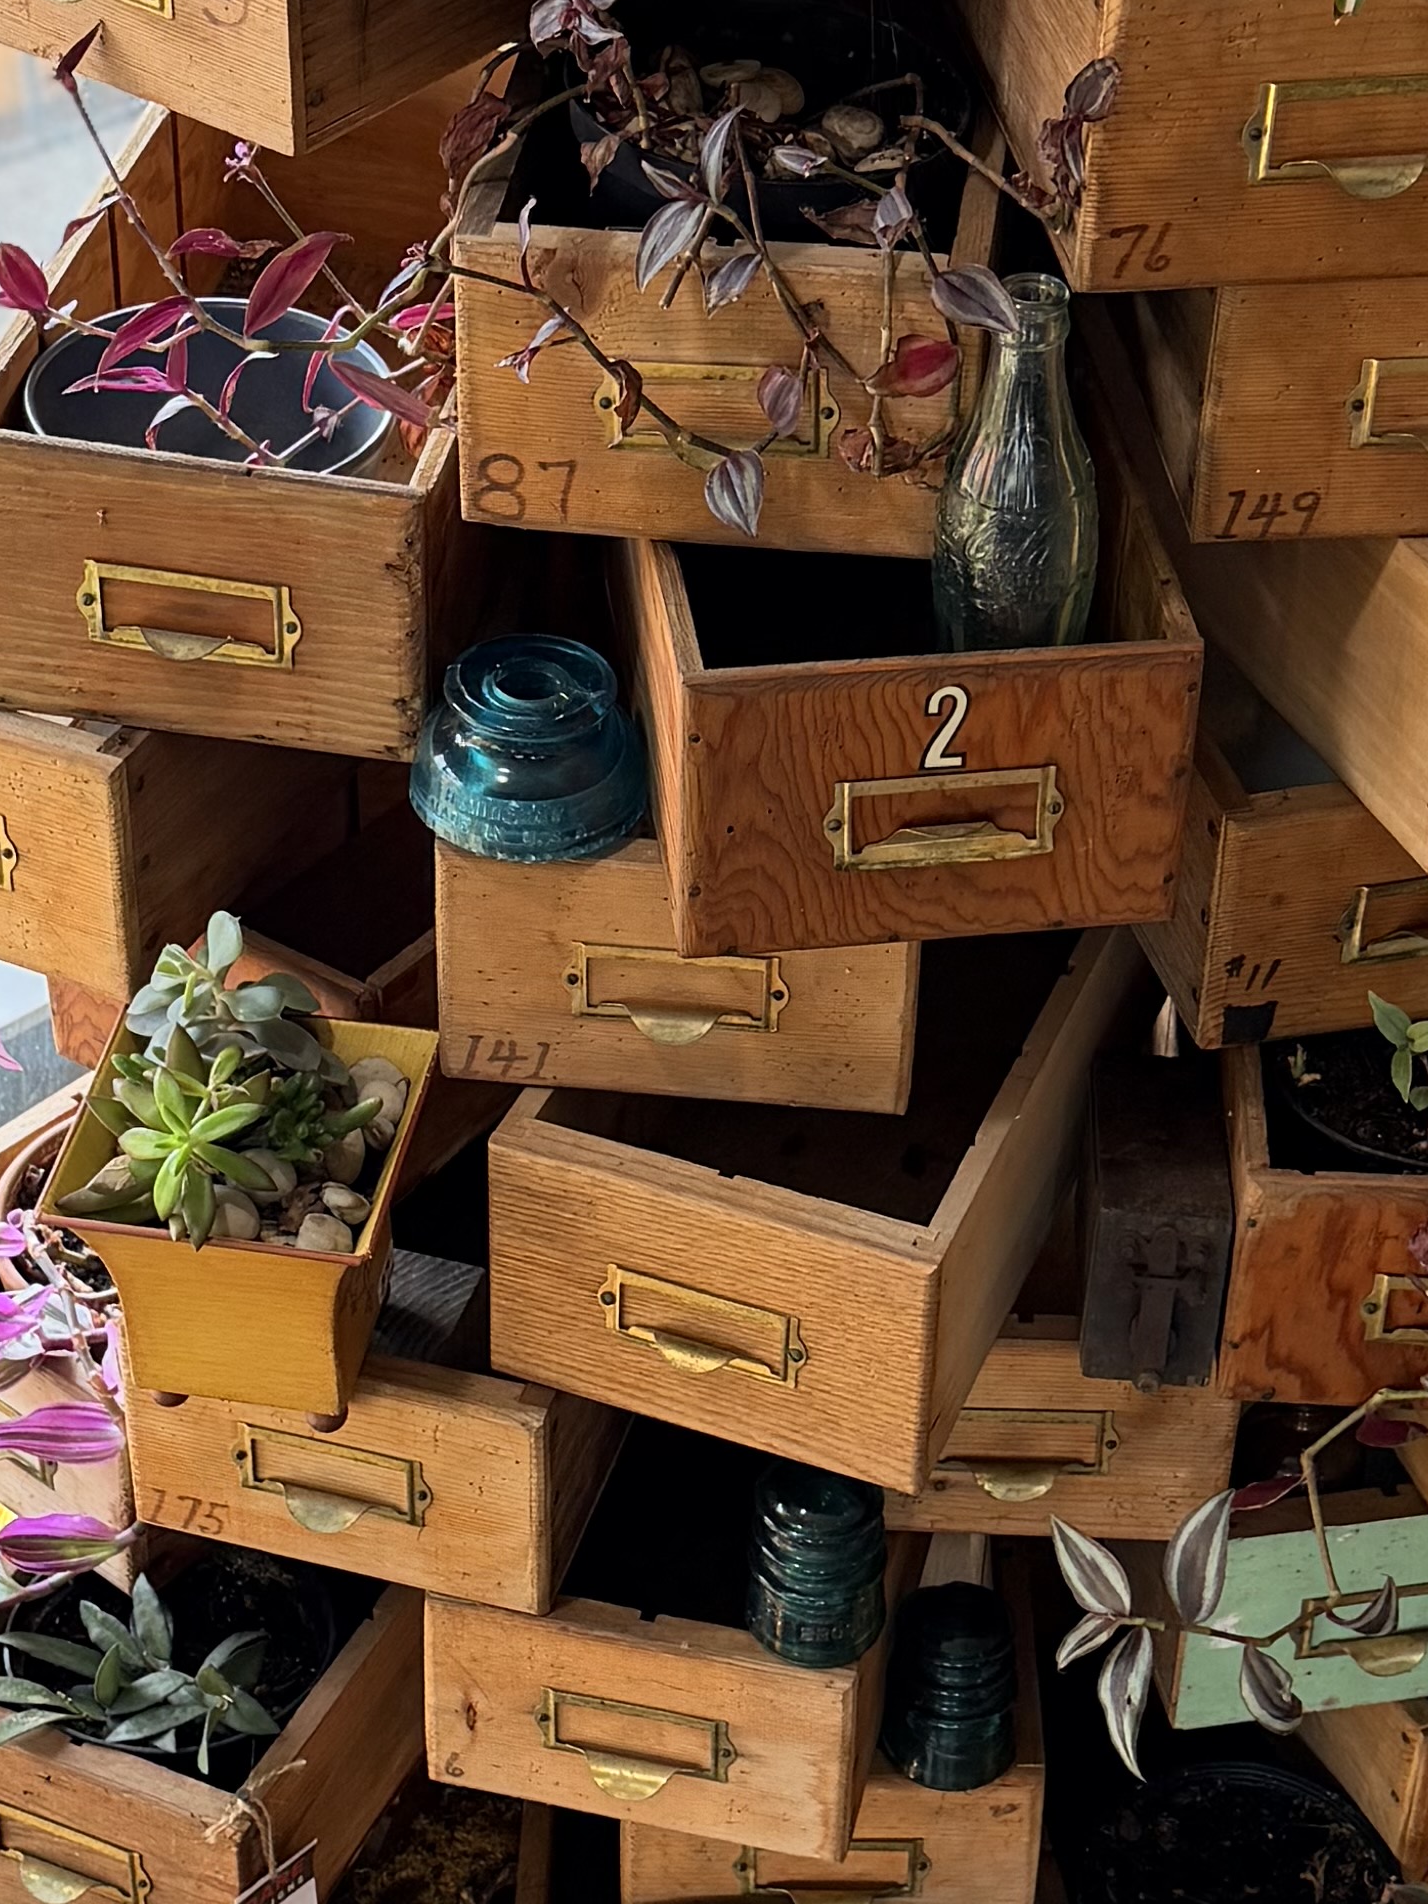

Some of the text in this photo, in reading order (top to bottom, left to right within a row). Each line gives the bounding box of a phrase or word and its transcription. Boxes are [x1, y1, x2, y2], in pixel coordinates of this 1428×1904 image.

[1107, 221, 1175, 279] 76
[474, 452, 577, 524] 87
[1212, 488, 1323, 540] 149
[918, 683, 972, 772] 2
[461, 1033, 551, 1081] 141
[149, 1487, 231, 1536] 175
[444, 1751, 465, 1778] 6
